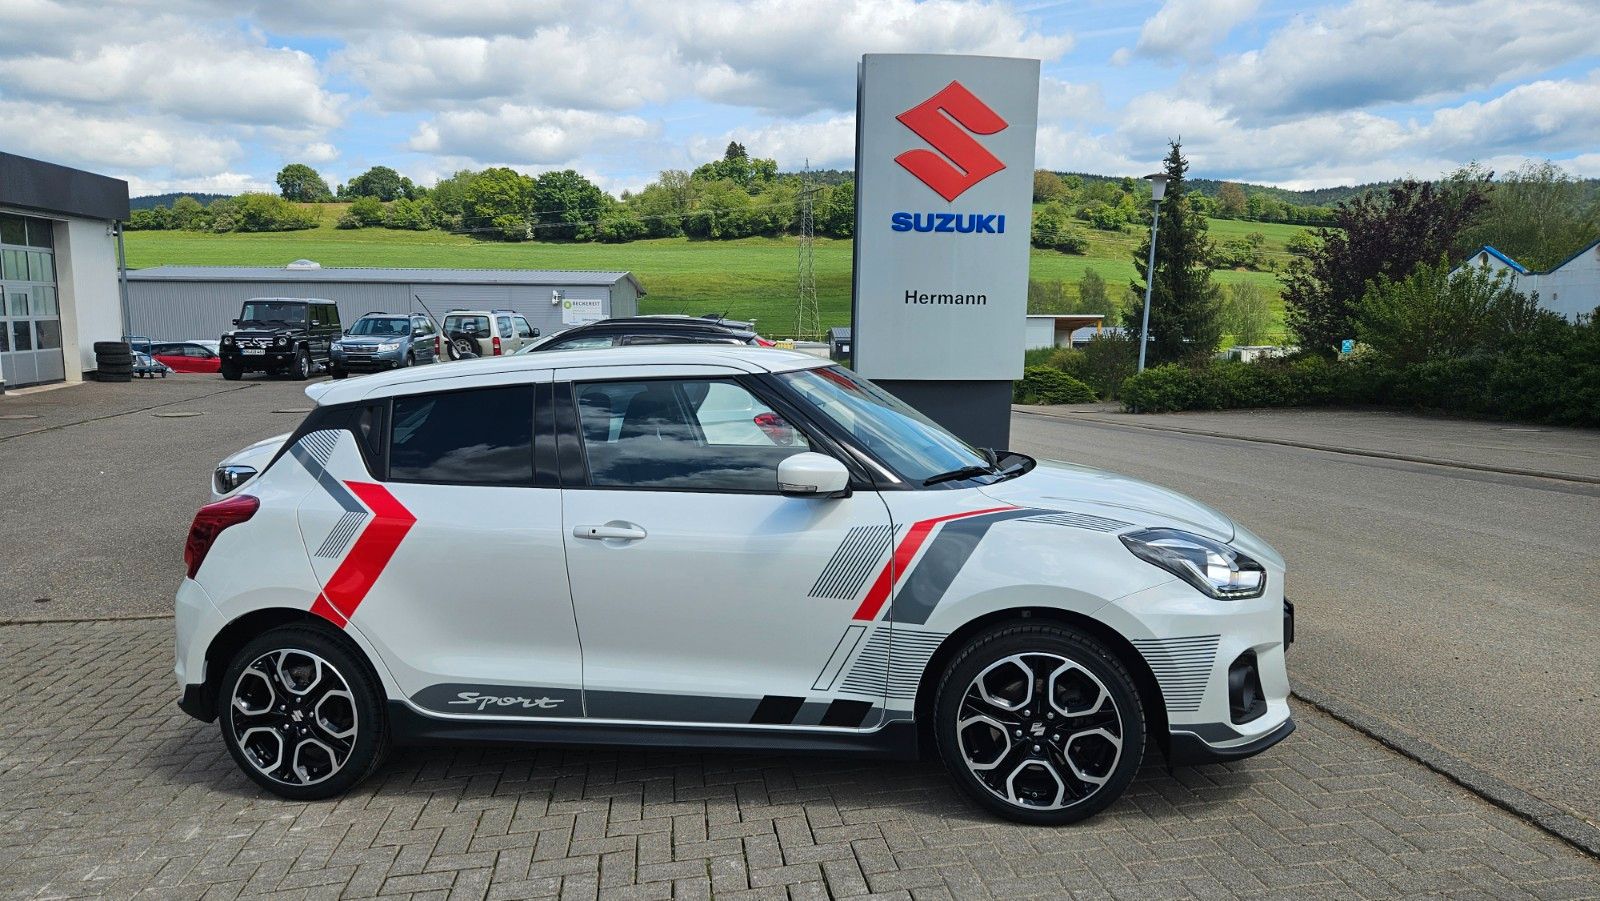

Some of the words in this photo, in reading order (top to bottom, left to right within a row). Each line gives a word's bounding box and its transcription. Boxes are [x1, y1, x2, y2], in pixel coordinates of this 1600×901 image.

[891, 212, 1006, 234] SUZUKI
[904, 289, 988, 305] Hermann
[447, 692, 564, 711] Sport
